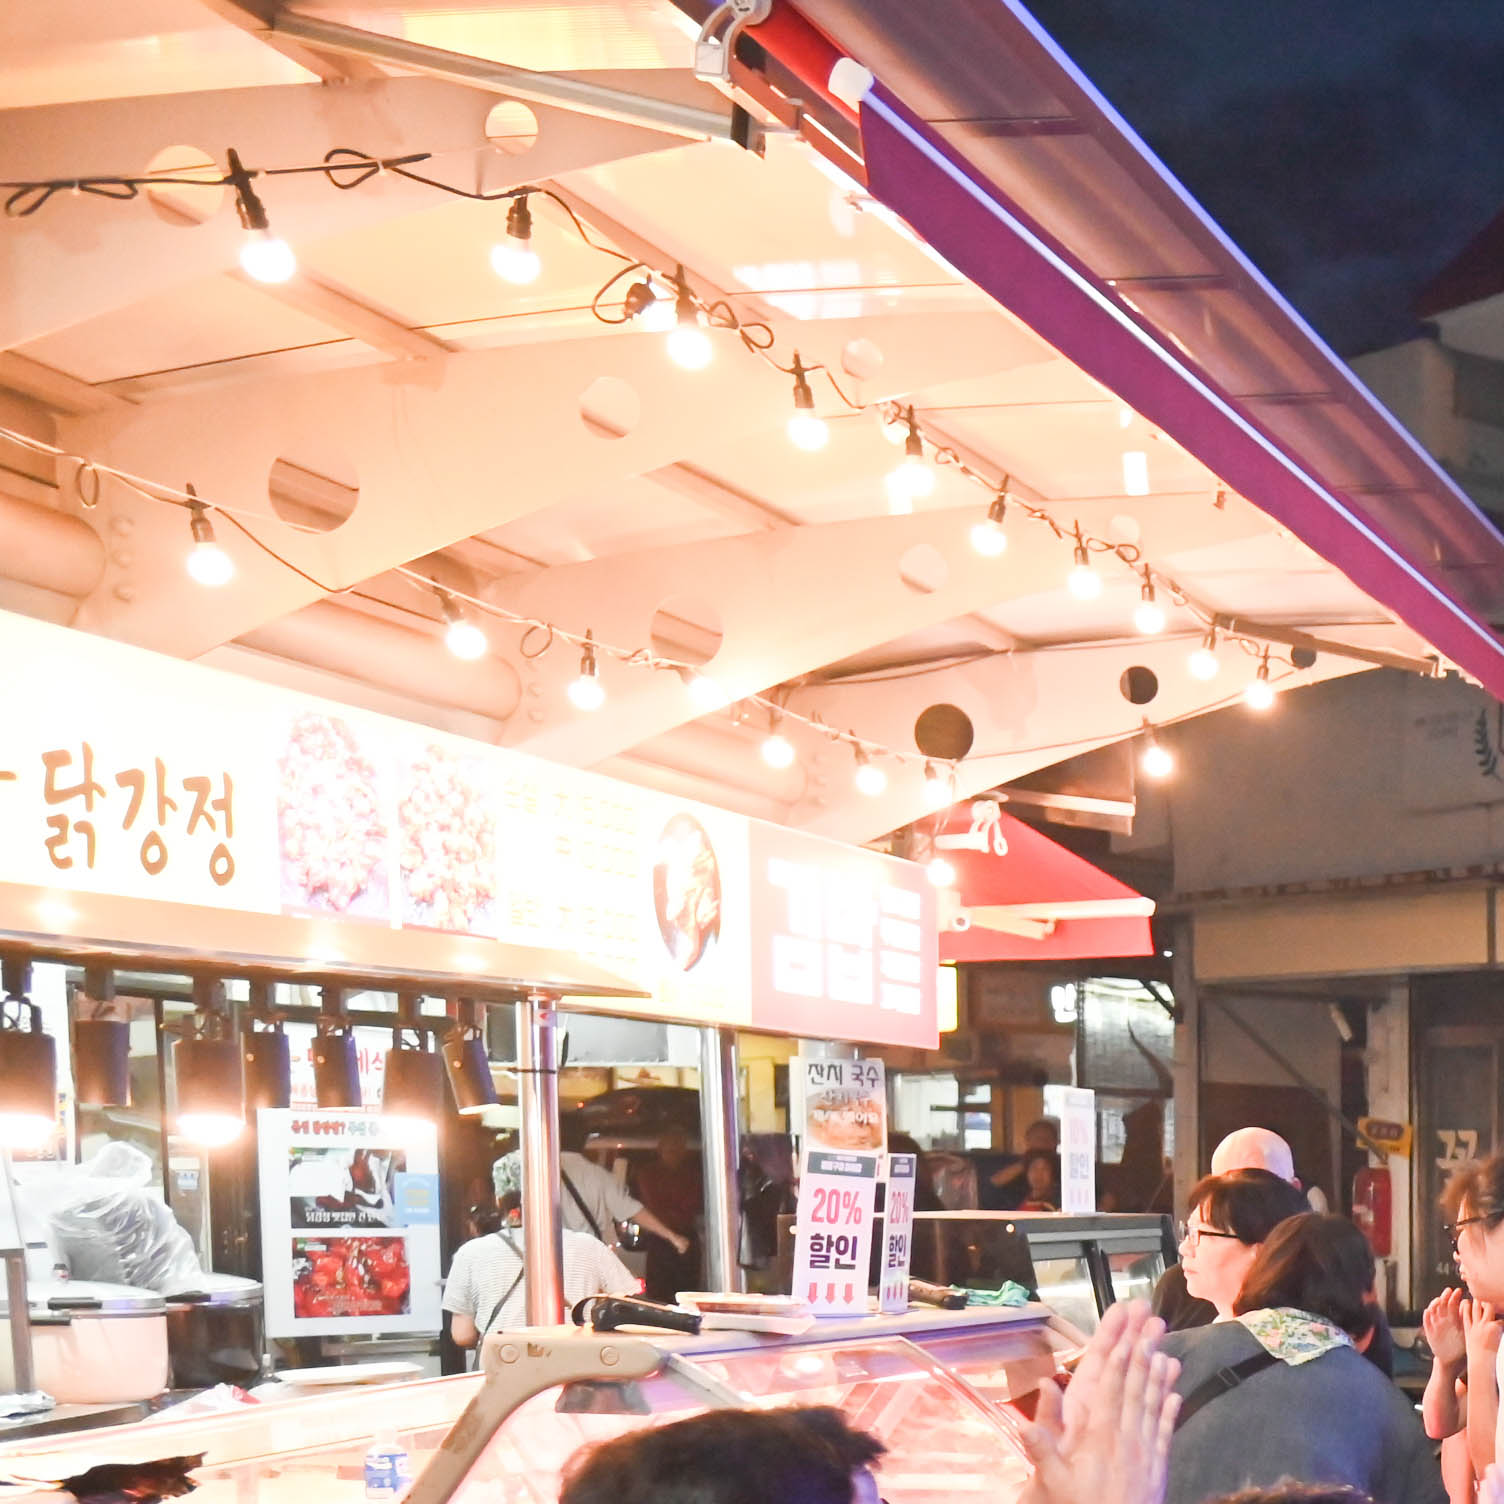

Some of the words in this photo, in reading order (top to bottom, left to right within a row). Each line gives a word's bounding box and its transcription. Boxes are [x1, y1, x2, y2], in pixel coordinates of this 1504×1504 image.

[42, 741, 235, 886] 닭강정
[808, 1063, 843, 1085] 잔치
[851, 1064, 880, 1088] 국수
[811, 1187, 862, 1225] 20%
[809, 1232, 858, 1270] 할인
